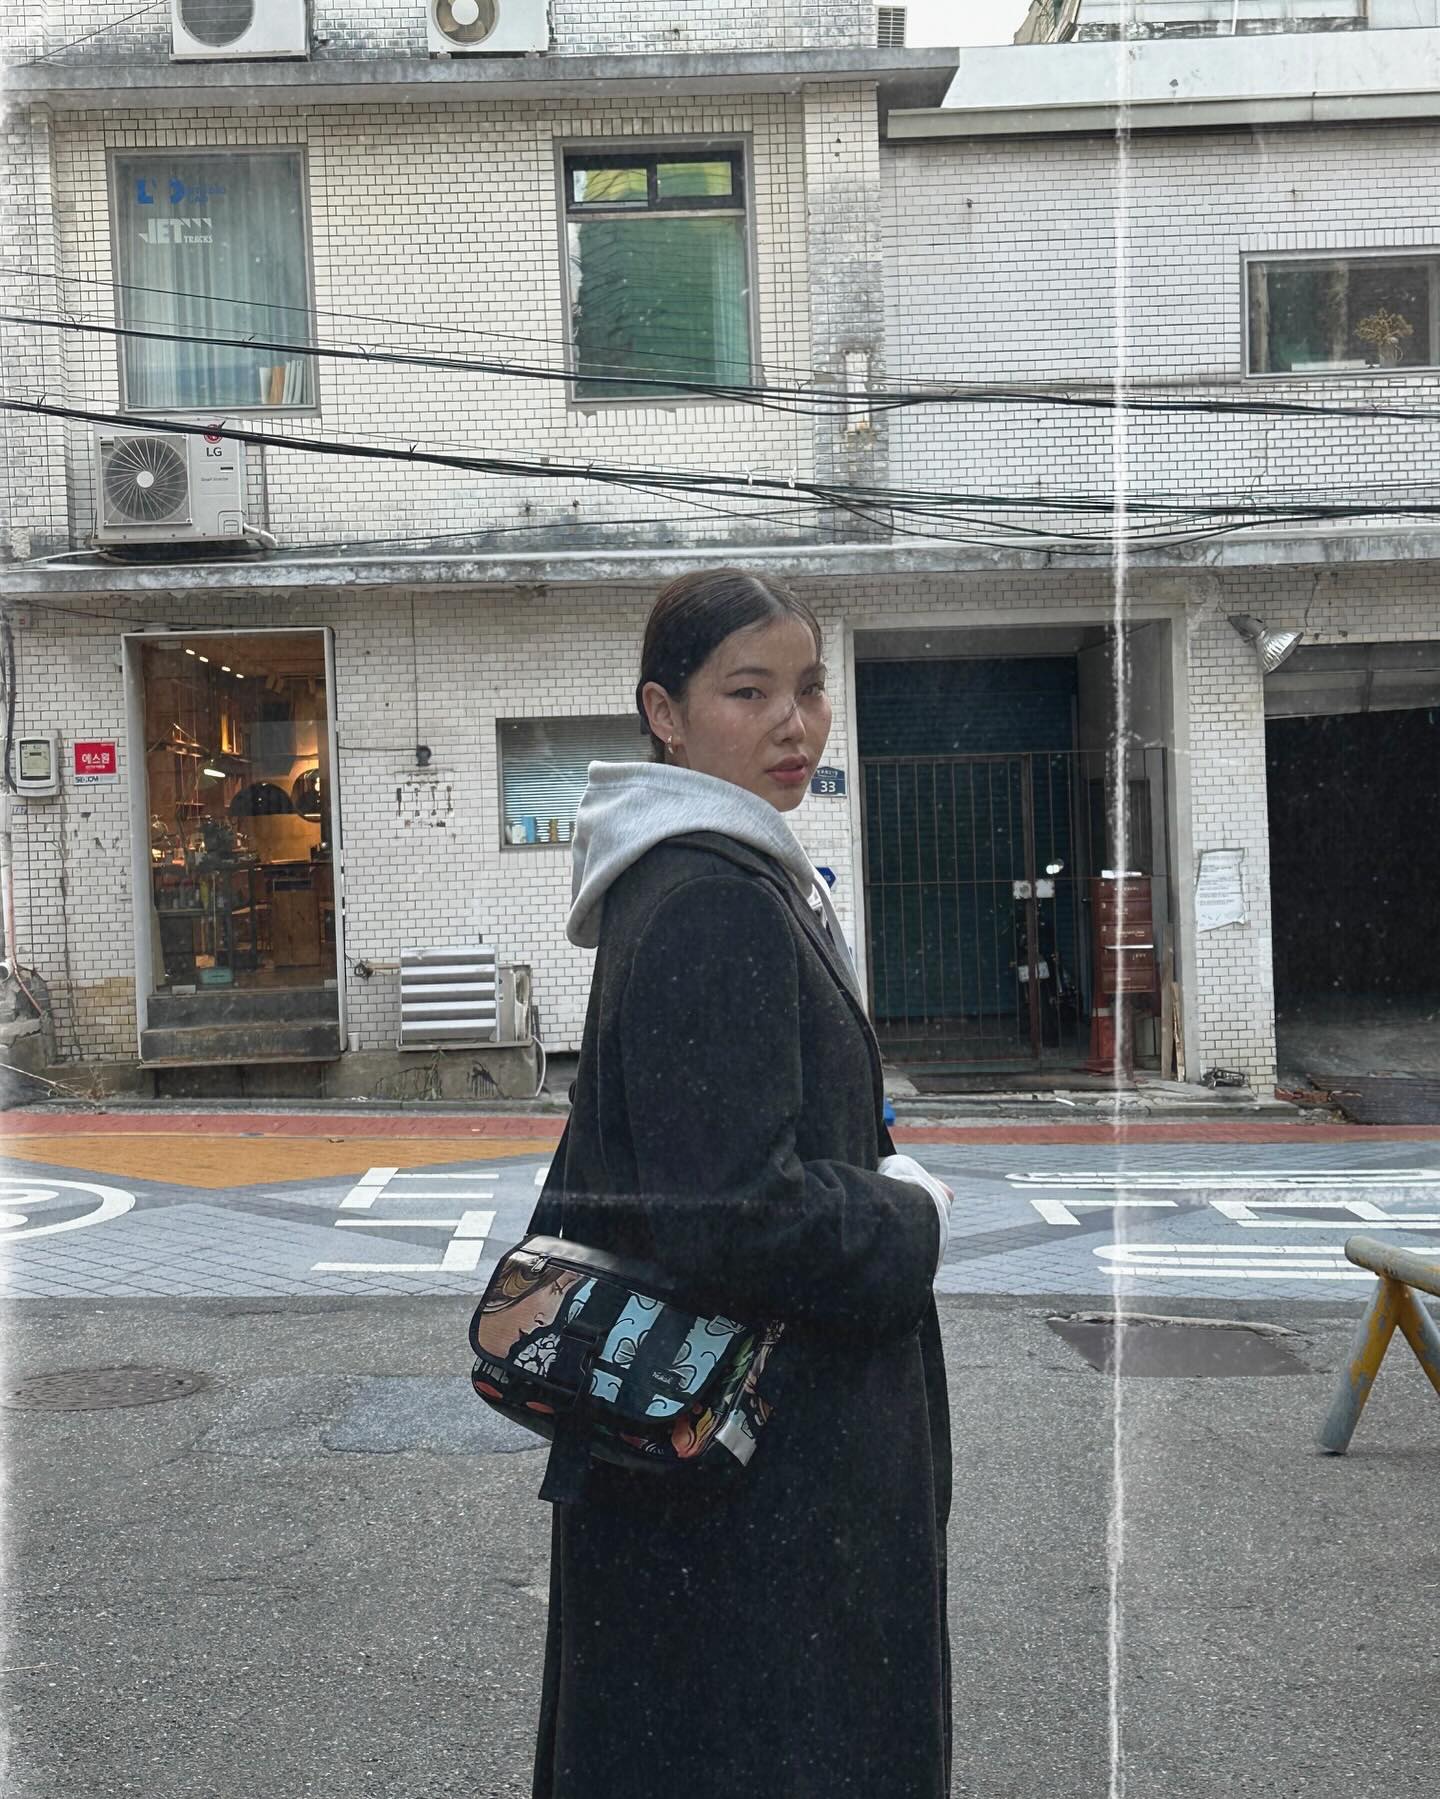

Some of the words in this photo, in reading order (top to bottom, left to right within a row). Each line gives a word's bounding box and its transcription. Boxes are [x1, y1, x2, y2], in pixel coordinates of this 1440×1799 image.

[139, 218, 185, 244] JET
[184, 235, 213, 243] TRACKS
[206, 447, 223, 457] LG
[82, 752, 110, 765] 에스원
[820, 780, 836, 793] 33
